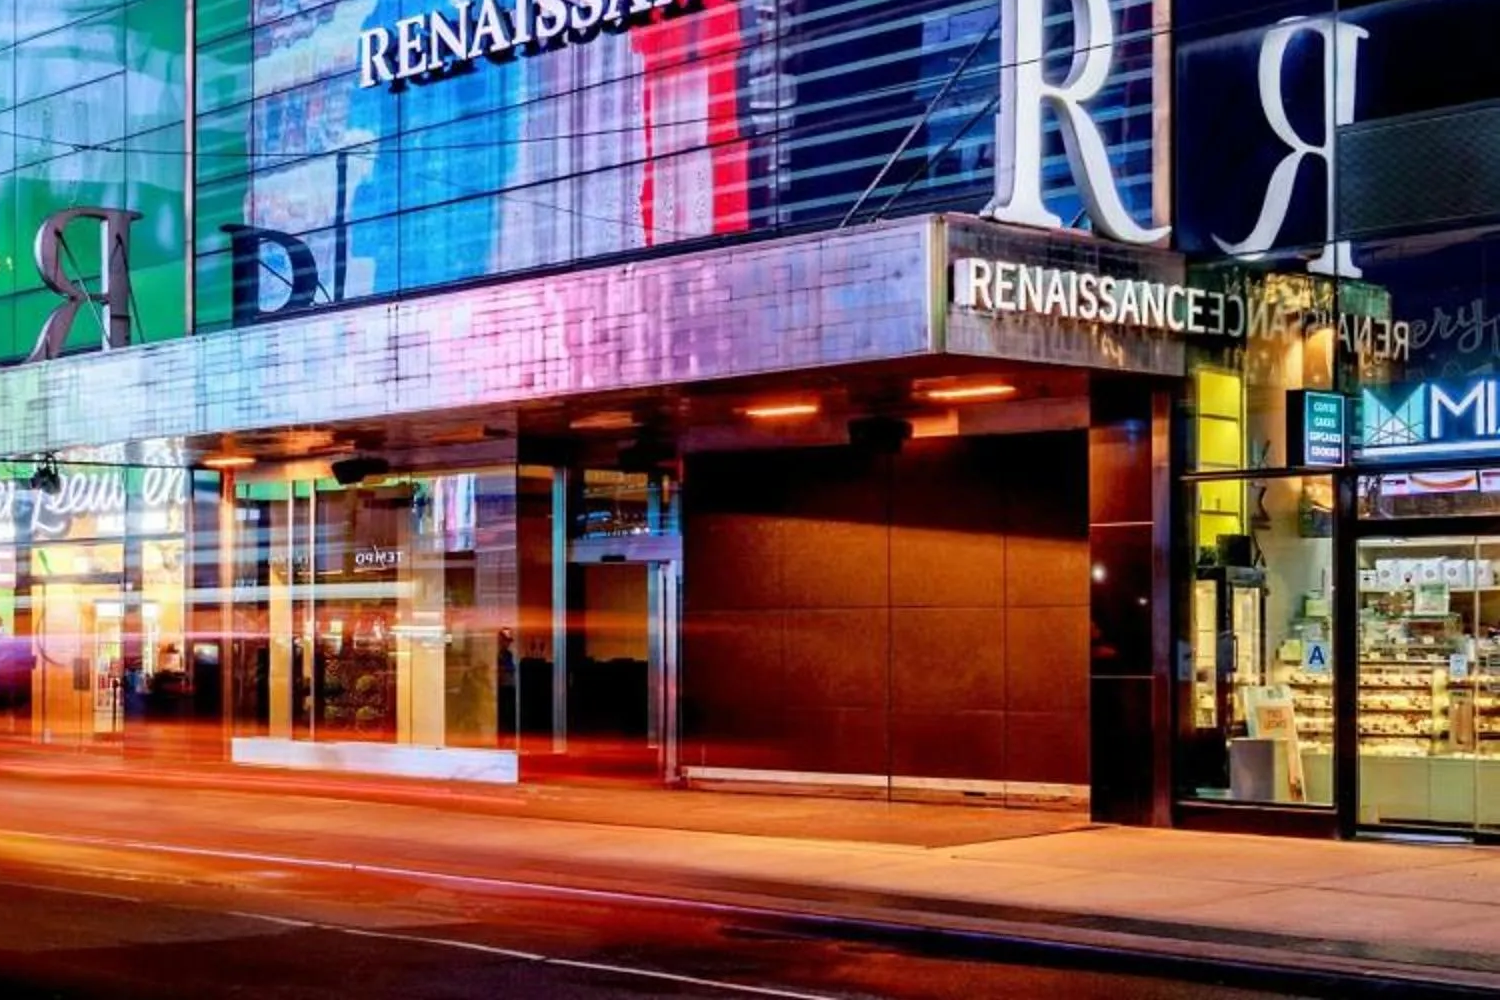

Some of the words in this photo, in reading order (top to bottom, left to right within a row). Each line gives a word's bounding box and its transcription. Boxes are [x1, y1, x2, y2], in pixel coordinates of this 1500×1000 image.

[961, 258, 1207, 336] RENAISSANCE
[1429, 380, 1500, 439] MI
[1308, 645, 1326, 665] A
